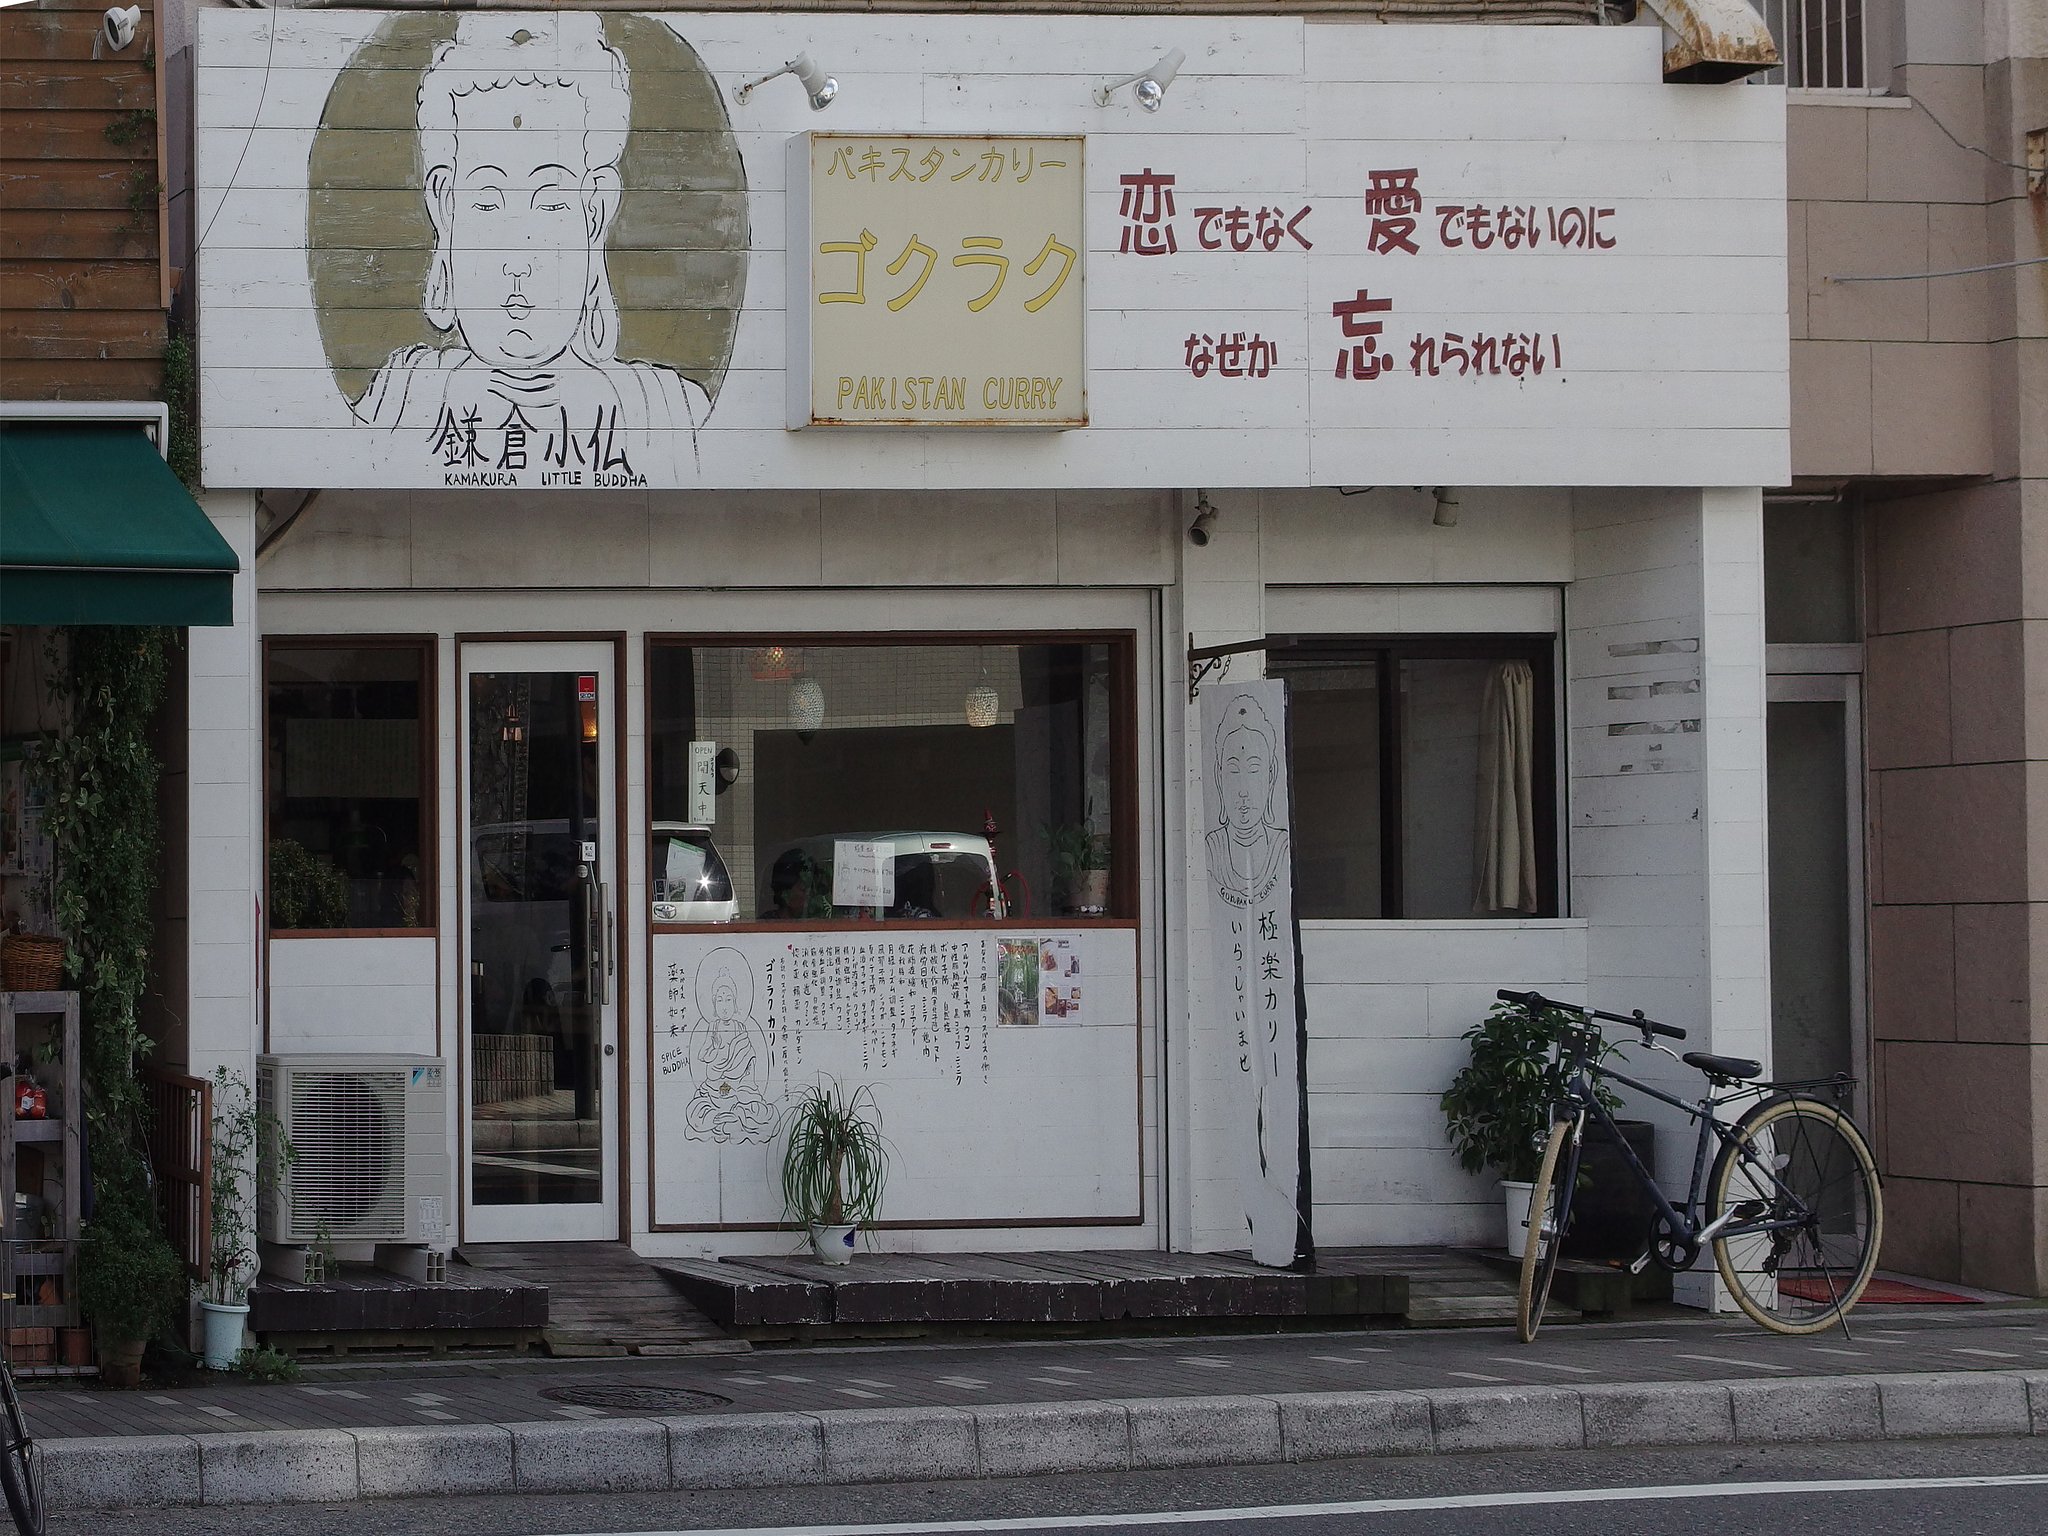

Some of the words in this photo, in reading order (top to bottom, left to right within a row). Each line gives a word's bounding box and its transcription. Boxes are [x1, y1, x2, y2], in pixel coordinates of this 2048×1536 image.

[827, 145, 1067, 183] パキスタンカリー
[818, 227, 1077, 313] ゴクラク
[1184, 331, 1279, 379] なぜか
[837, 375, 967, 410] PAKISTAN
[982, 376, 1063, 410] CURRY
[425, 402, 634, 476] 鎌倉小仏
[444, 472, 518, 487] KAMAKURA
[541, 471, 583, 486] LITTLE
[594, 473, 648, 488] BUDDHA
[694, 746, 713, 755] OPEN
[1259, 874, 1278, 899] CURRY
[1231, 920, 1252, 1073] いらっしゃいませ
[1258, 910, 1283, 1077] 極楽カリー
[660, 1047, 682, 1063] SPICE
[662, 1057, 690, 1075] BUDDHA
